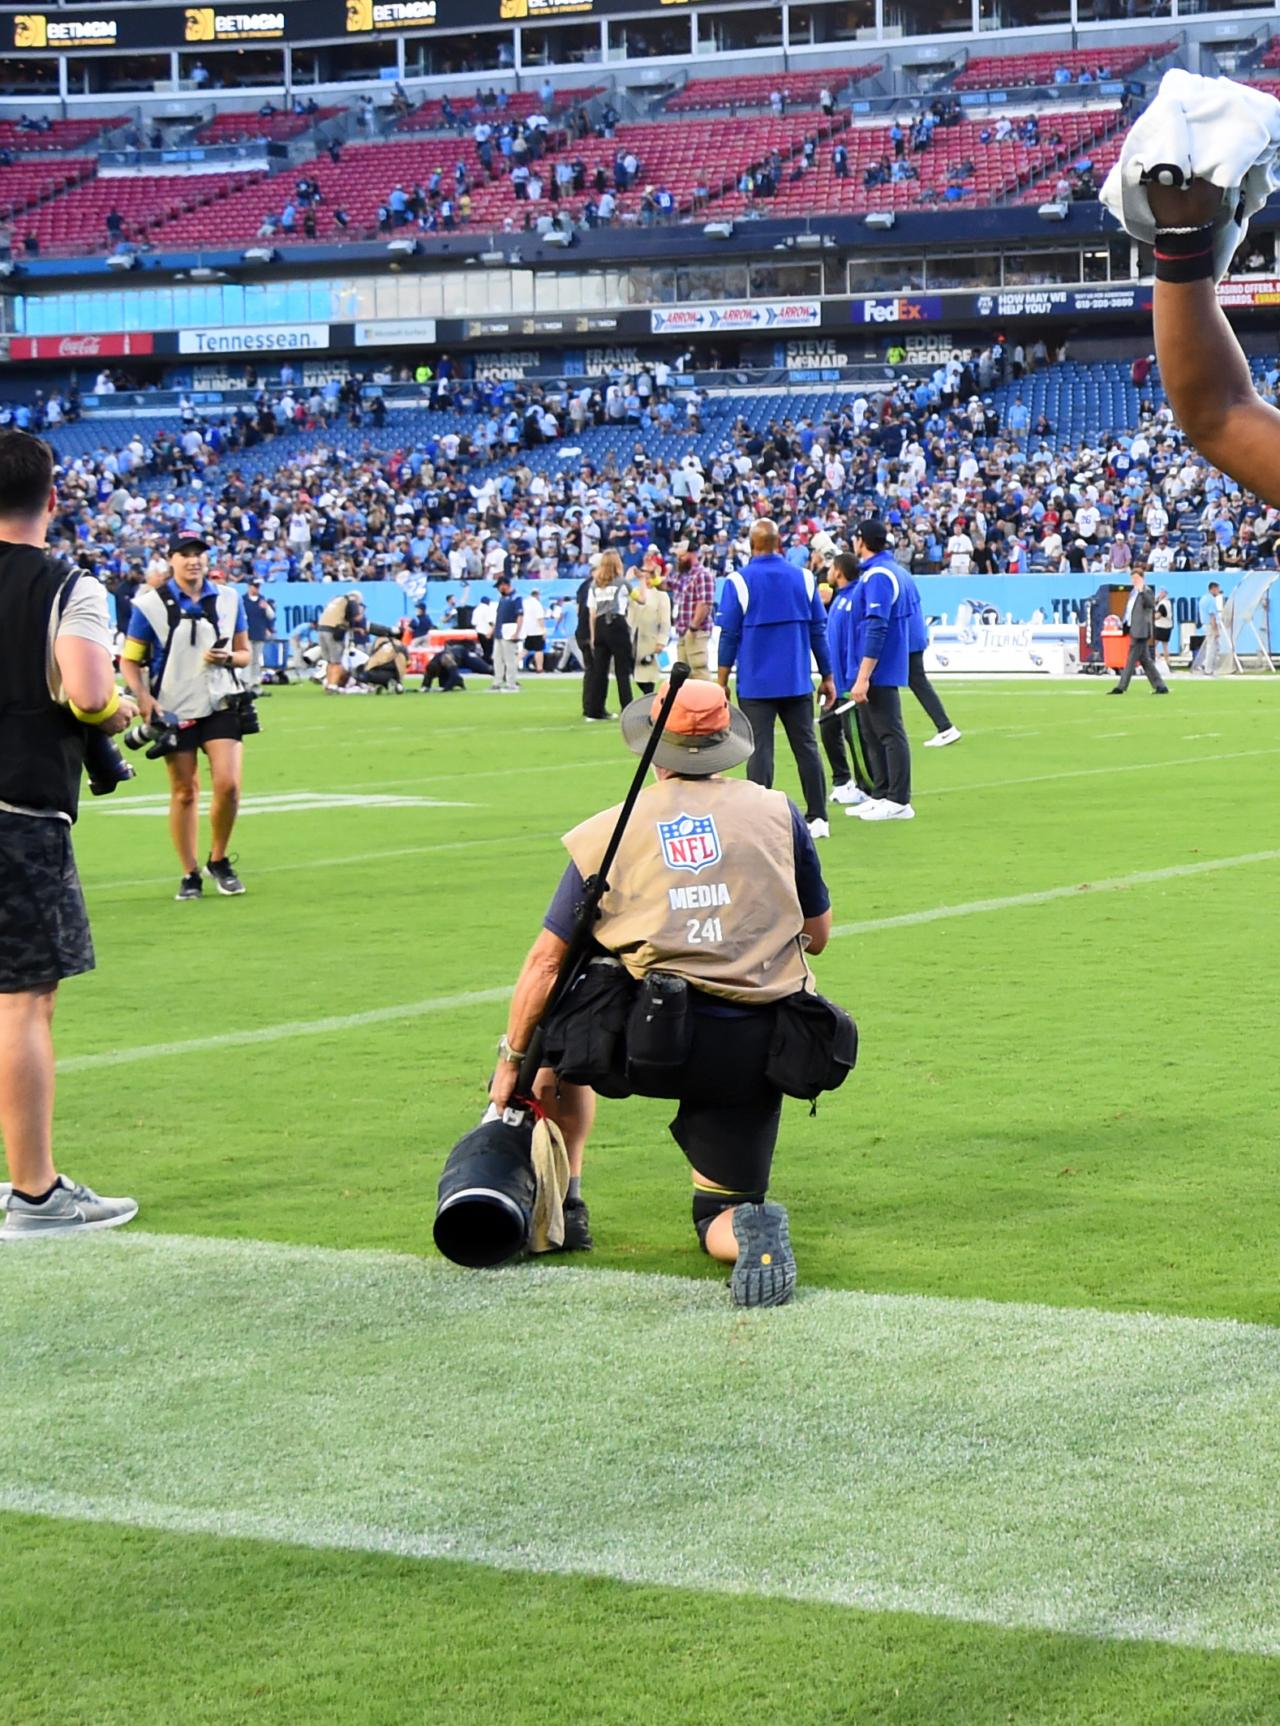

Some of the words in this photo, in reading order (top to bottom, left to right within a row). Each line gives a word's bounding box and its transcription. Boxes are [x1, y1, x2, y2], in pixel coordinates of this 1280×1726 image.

[373, 1, 437, 21] BETMGM
[47, 20, 117, 39] BETMGM
[215, 13, 285, 32] BETMGM
[864, 299, 923, 322] FedEx
[787, 340, 837, 356] STEVE
[905, 334, 953, 350] EDDIE
[475, 352, 540, 367] WARREN
[586, 348, 638, 364] FRANK
[668, 836, 714, 864] NFL
[669, 883, 732, 910] MEDIA
[686, 917, 722, 944] 241
